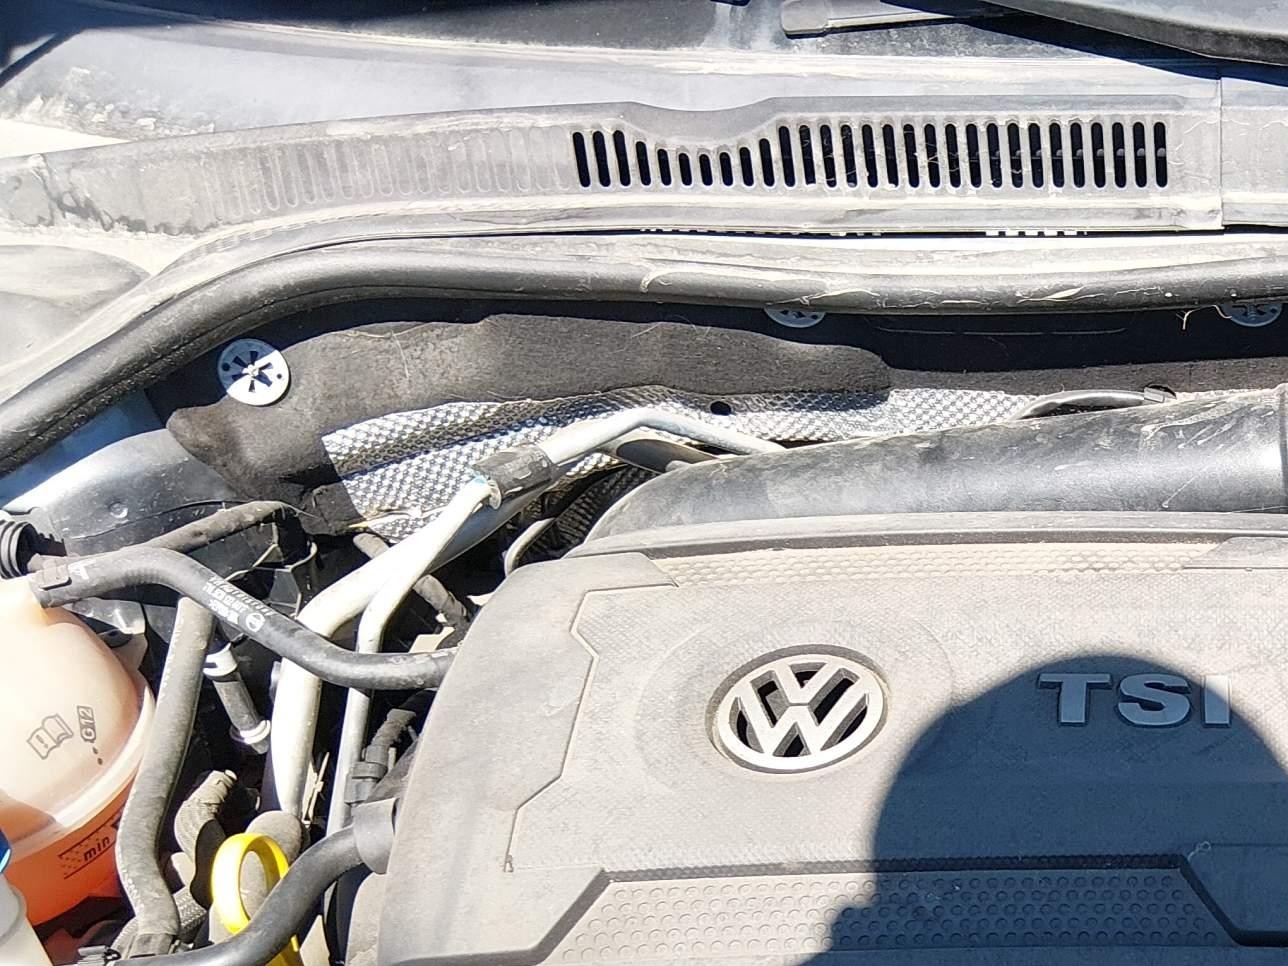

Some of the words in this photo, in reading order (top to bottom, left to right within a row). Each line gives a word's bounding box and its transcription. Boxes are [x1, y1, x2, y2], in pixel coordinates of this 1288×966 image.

[1038, 673, 1232, 728] TSI
[79, 707, 95, 741] G12
[83, 835, 111, 861] min
